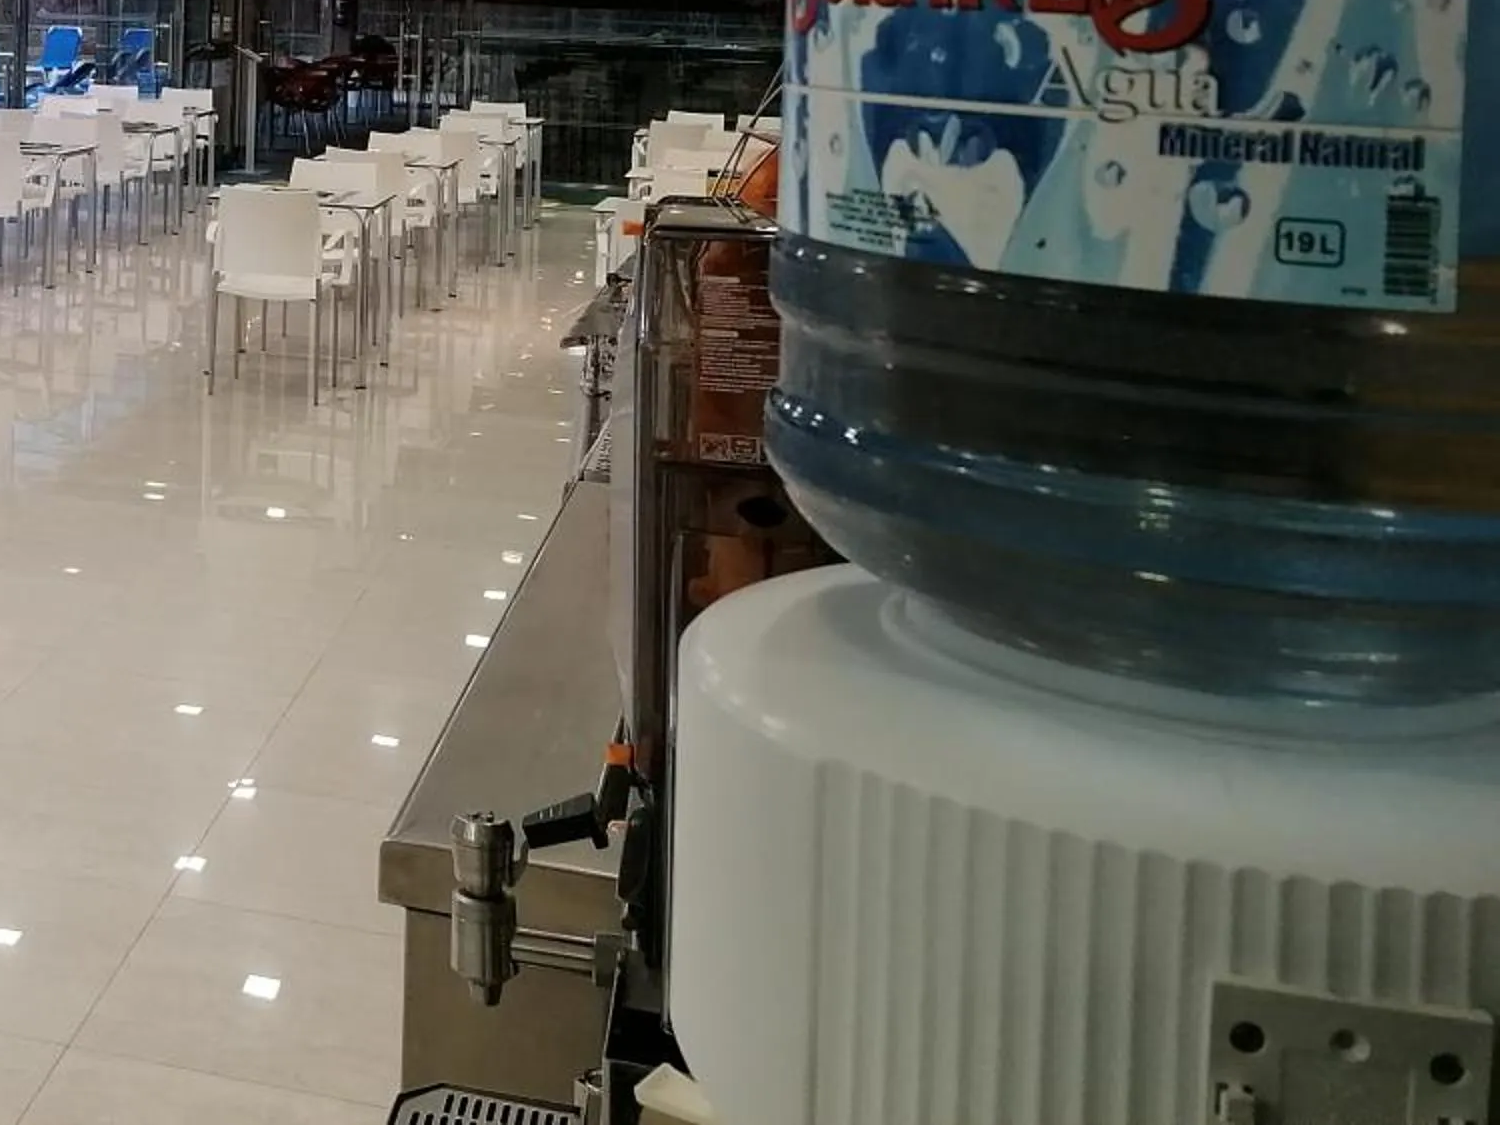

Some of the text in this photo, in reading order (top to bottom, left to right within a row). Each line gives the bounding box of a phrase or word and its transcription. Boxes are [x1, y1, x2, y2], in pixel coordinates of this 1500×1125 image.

[1029, 46, 1224, 124] Agua
[1158, 122, 1426, 172] Mineral Natural
